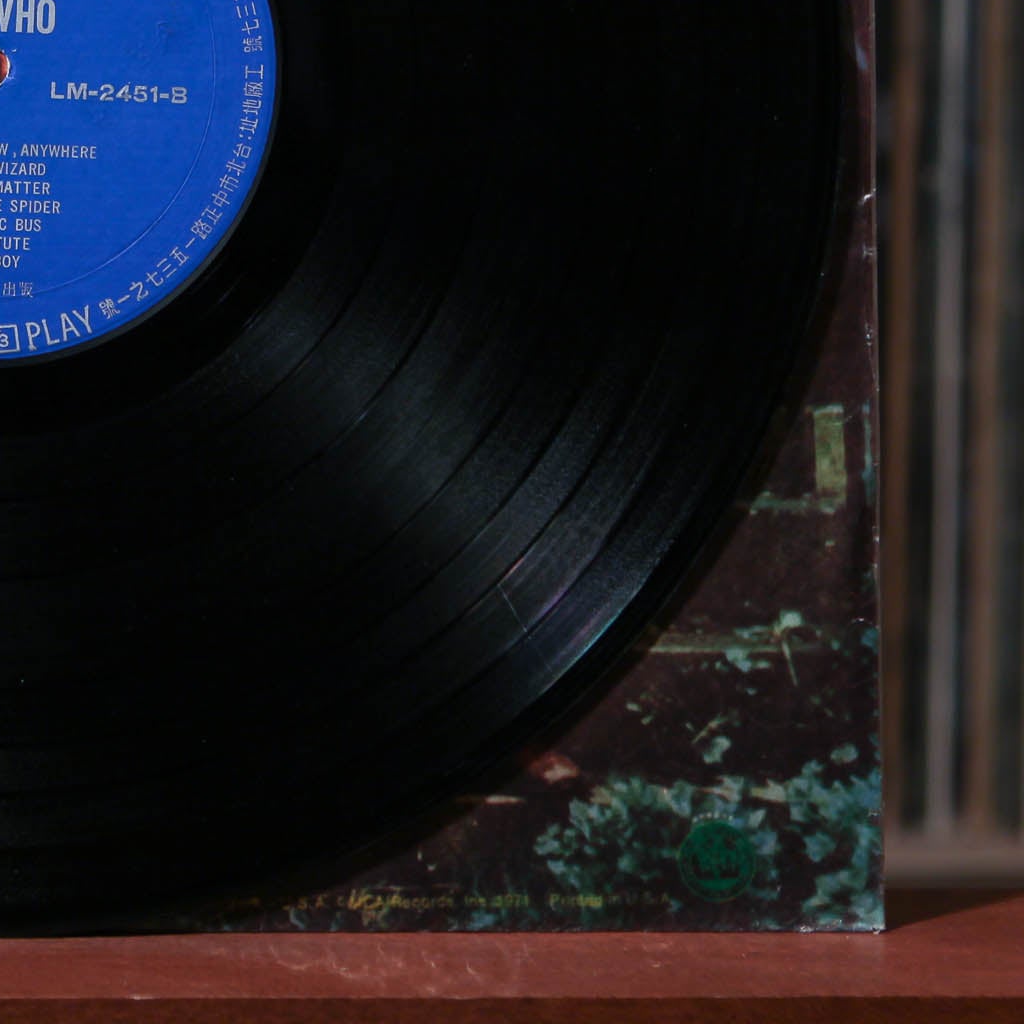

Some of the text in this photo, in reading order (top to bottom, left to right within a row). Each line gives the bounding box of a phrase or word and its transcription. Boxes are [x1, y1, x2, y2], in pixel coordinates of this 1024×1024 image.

[50, 81, 187, 104] LM-2451-B
[10, 199, 61, 214] SPIDER
[15, 218, 41, 232] BUS
[25, 304, 92, 350] PLAY
